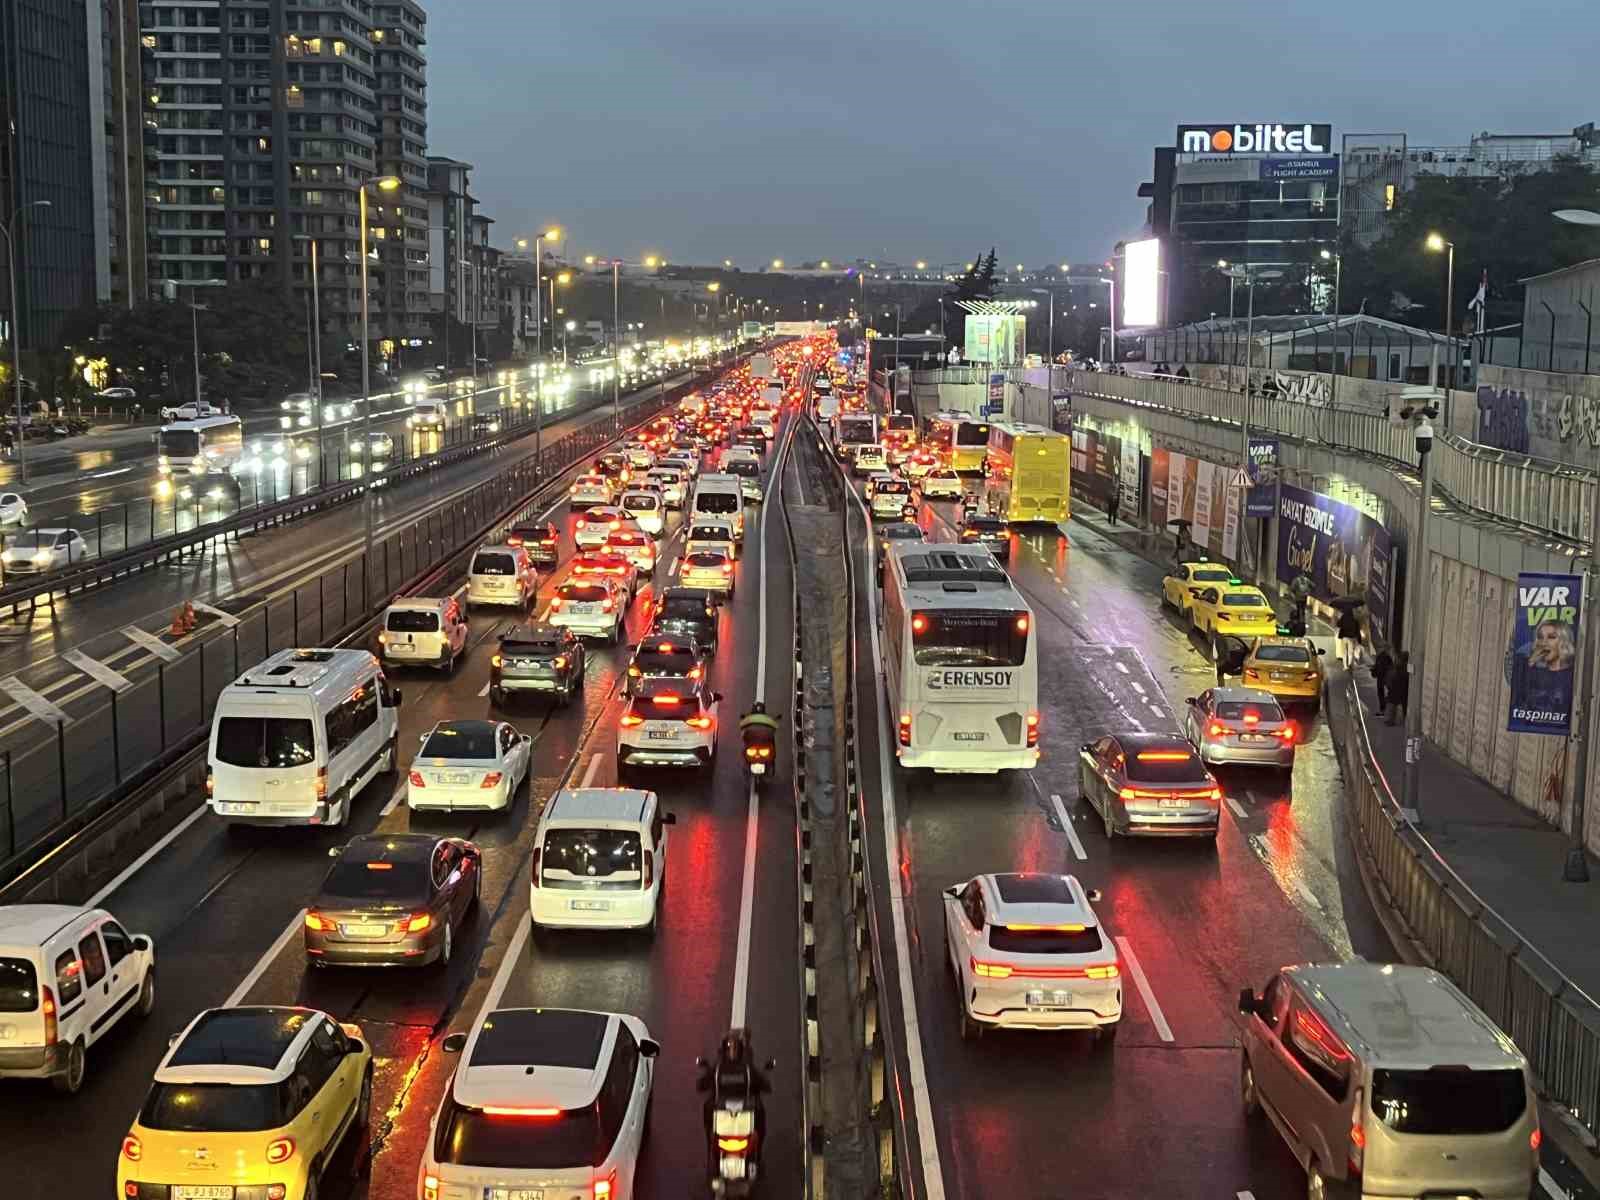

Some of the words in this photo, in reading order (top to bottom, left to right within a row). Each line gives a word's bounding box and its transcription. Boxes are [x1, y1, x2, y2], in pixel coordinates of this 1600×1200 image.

[1249, 445, 1273, 456] VAR
[1281, 497, 1304, 524] HAYAT
[1519, 586, 1570, 607] VAR
[1527, 606, 1577, 626] VAR
[943, 671, 1013, 686] ERENSOY
